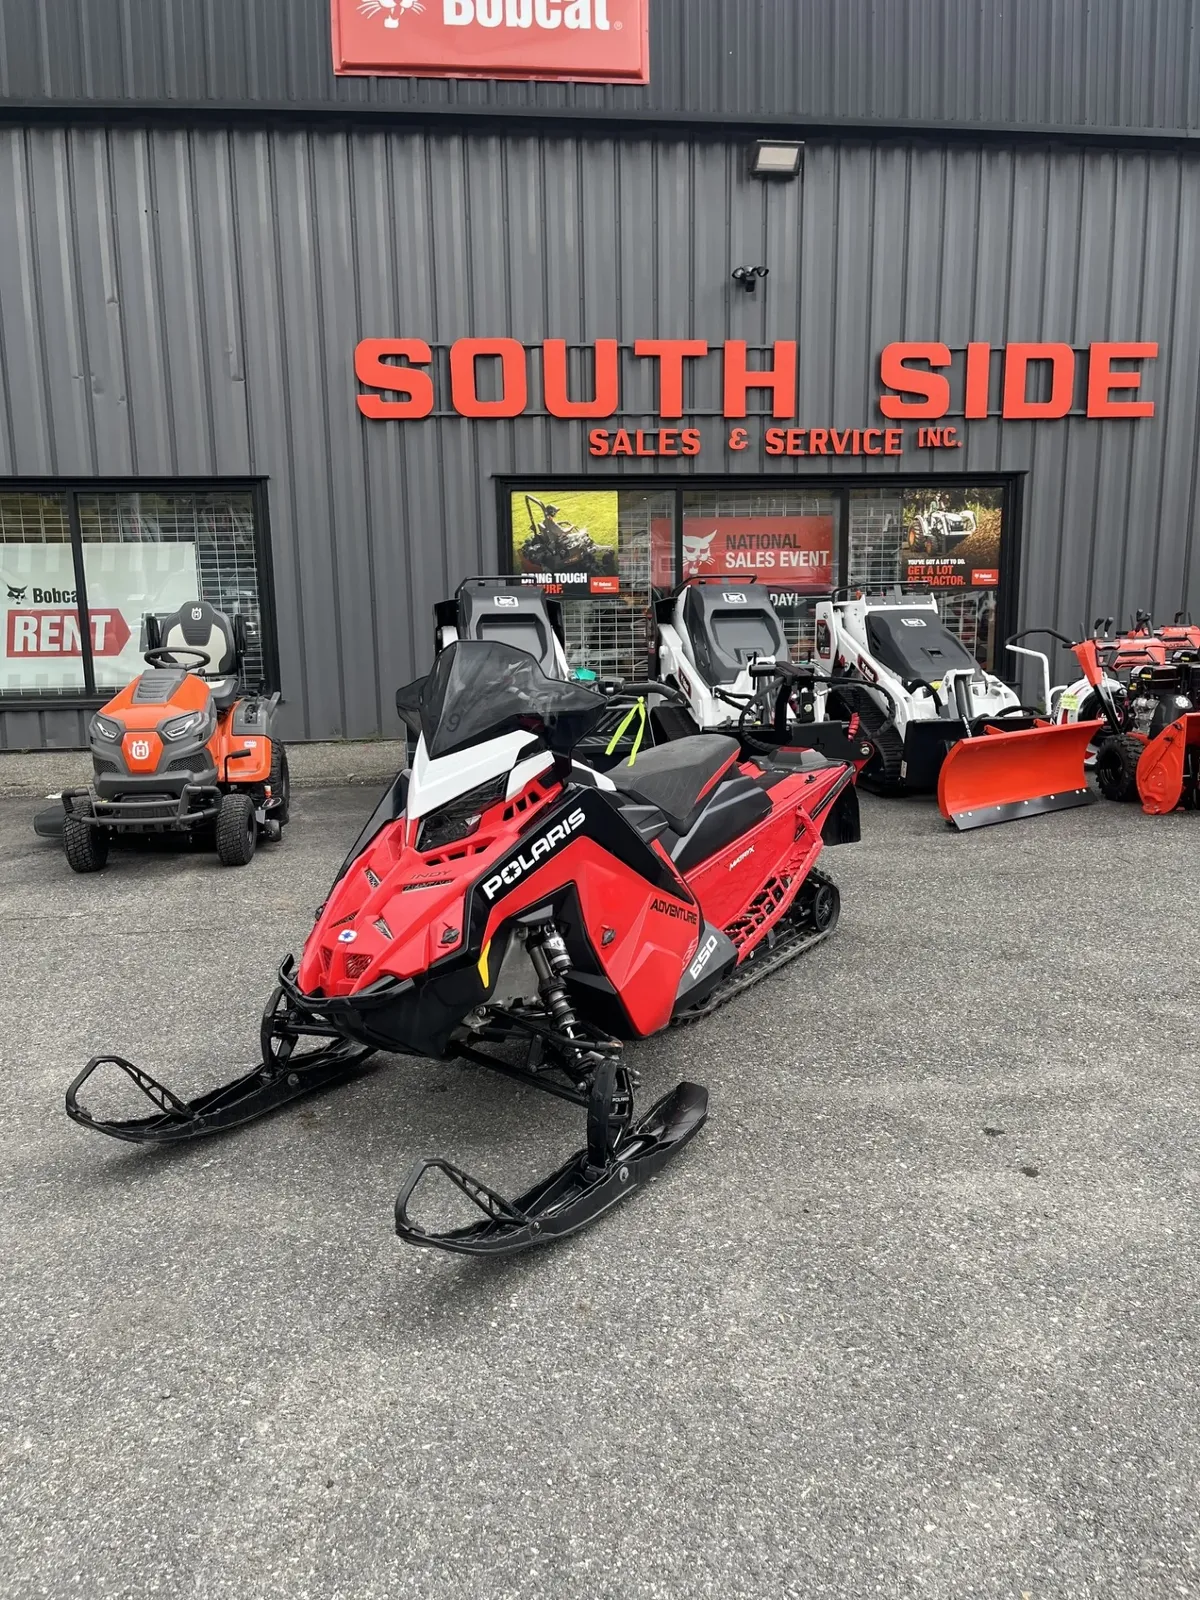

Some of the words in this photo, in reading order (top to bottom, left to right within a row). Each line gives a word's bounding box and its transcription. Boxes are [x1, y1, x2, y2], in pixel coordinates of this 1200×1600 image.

[354, 337, 797, 419] SOUTH
[879, 341, 1159, 419] SIDE
[589, 428, 701, 456] SALES
[728, 427, 749, 451] &
[765, 427, 904, 456] SERVICE
[917, 426, 964, 449] INC.
[726, 533, 801, 550] NATIONAL
[725, 551, 776, 569] SALES
[780, 550, 830, 568] EVENT
[554, 572, 588, 584] TOUGH
[907, 565, 925, 575] GET
[927, 565, 934, 575] A
[936, 565, 954, 575] LOT
[922, 575, 966, 586] TRACTOR.
[33, 587, 78, 604] Bobca
[13, 614, 112, 652] RENT
[482, 807, 586, 900] POLARIS
[410, 869, 453, 880] INDY
[650, 898, 698, 926] ADVENTURE
[689, 935, 718, 980] 650
